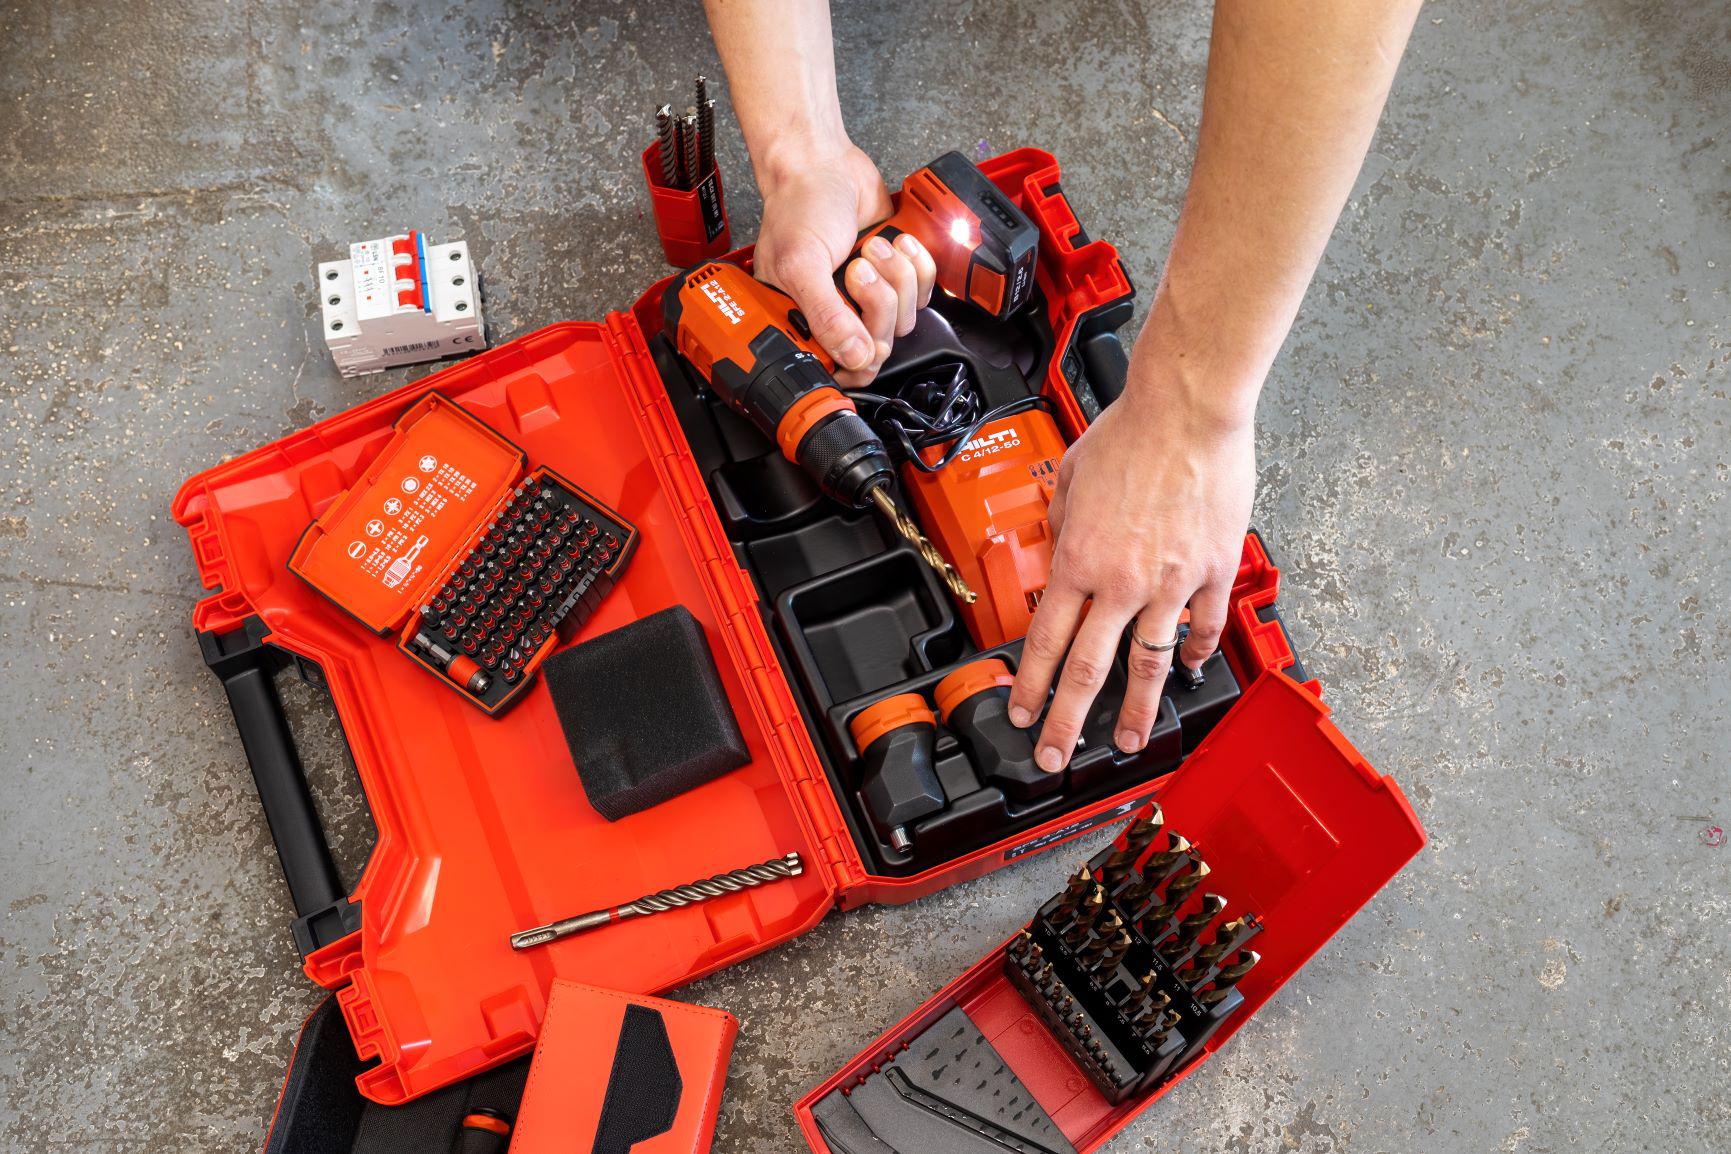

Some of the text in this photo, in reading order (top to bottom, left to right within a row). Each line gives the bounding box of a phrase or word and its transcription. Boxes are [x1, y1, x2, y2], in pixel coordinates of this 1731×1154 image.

[700, 282, 742, 325] HILTI
[710, 279, 746, 317] SFE 2-A12
[452, 335, 474, 346] CE
[961, 439, 1021, 462] C 4/12-50
[1152, 958, 1163, 971] 11.5
[1174, 984, 1181, 992] 11
[1190, 1003, 1202, 1017] 10.5
